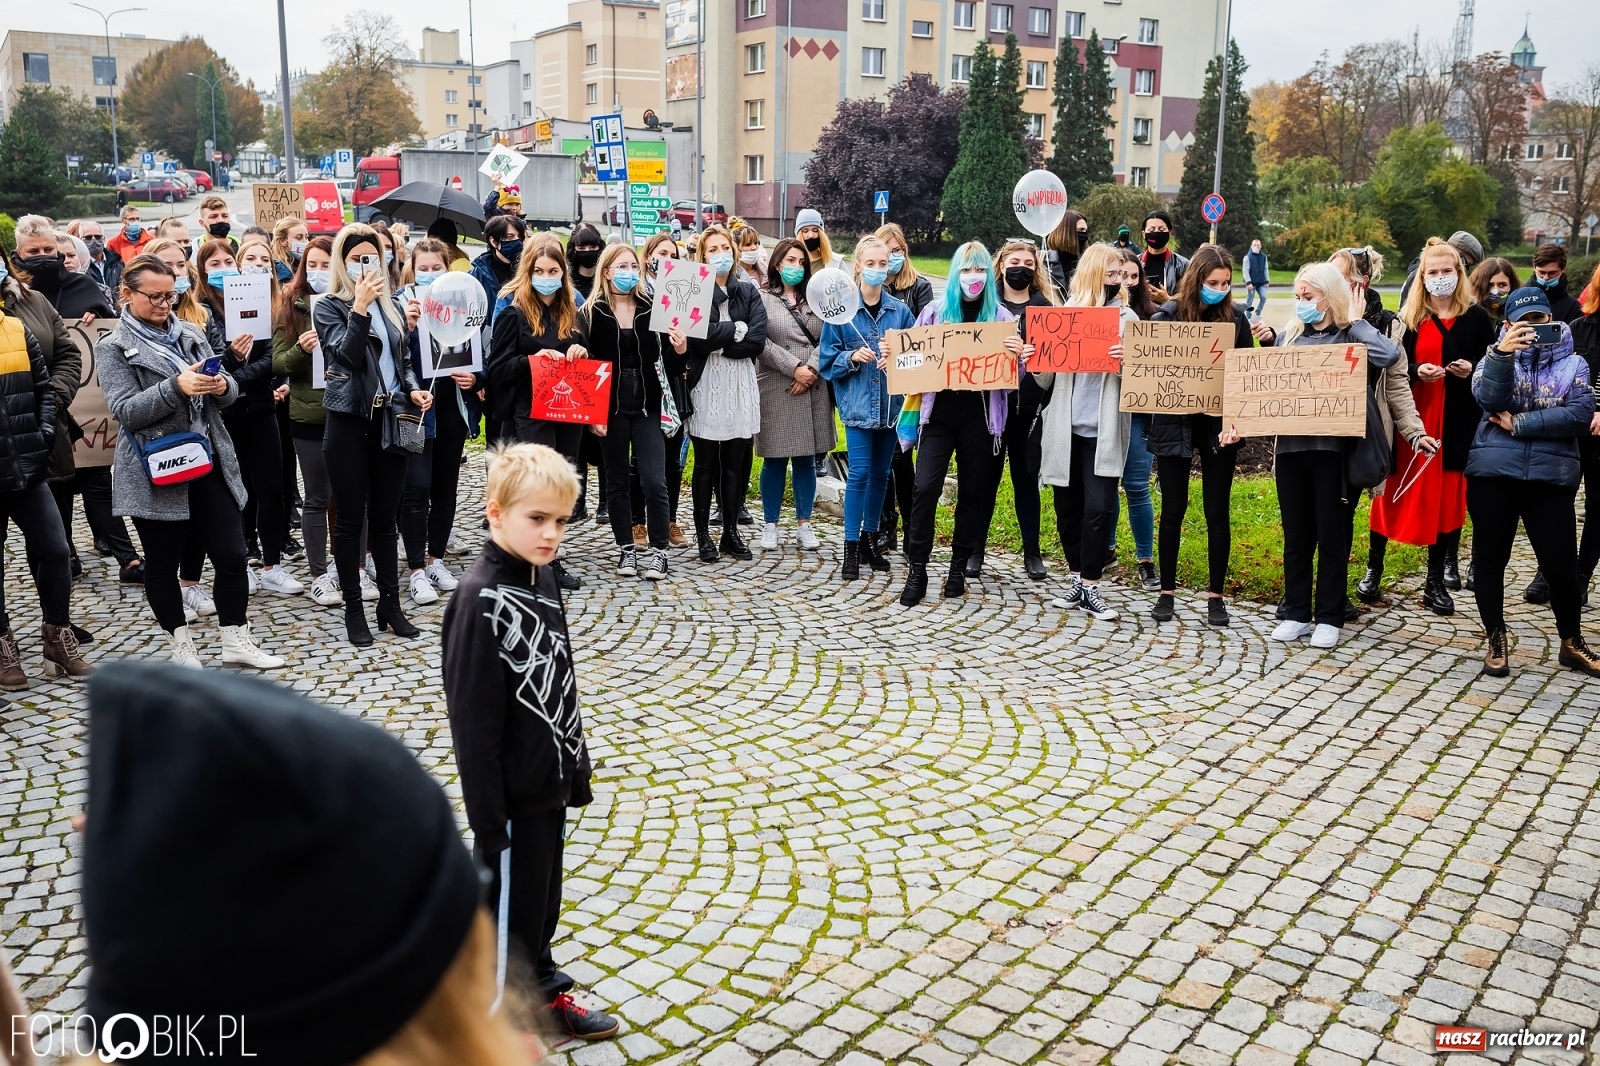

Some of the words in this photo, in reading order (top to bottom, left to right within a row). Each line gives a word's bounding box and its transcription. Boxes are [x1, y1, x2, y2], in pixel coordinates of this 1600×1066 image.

[258, 186, 300, 205] RZĄD
[272, 203, 285, 211] DO
[321, 199, 338, 210] dpd
[818, 296, 842, 311] hello
[822, 305, 846, 318] 2020
[1029, 311, 1083, 342] MOJE
[1082, 322, 1119, 338] CIAŁO
[1132, 323, 1160, 338] NIE
[1169, 324, 1213, 338] MACIE
[897, 329, 935, 354] Don't
[1132, 344, 1200, 358] SUMIENIA
[926, 352, 945, 370] my
[1238, 351, 1306, 373] WALCZCIE
[1320, 351, 1334, 367] Z
[573, 371, 596, 381] TEGO
[1131, 363, 1214, 382] ZMUSZAJĄC
[1157, 381, 1184, 394] NAS
[1243, 372, 1316, 393] WIRUSEM,
[1320, 371, 1348, 390] NIE
[1124, 392, 1148, 408] DO
[1153, 392, 1221, 410] RODZENIA
[1237, 400, 1248, 419] Z
[1258, 396, 1356, 418] KOBIETAMI
[157, 455, 188, 472] NIKE
